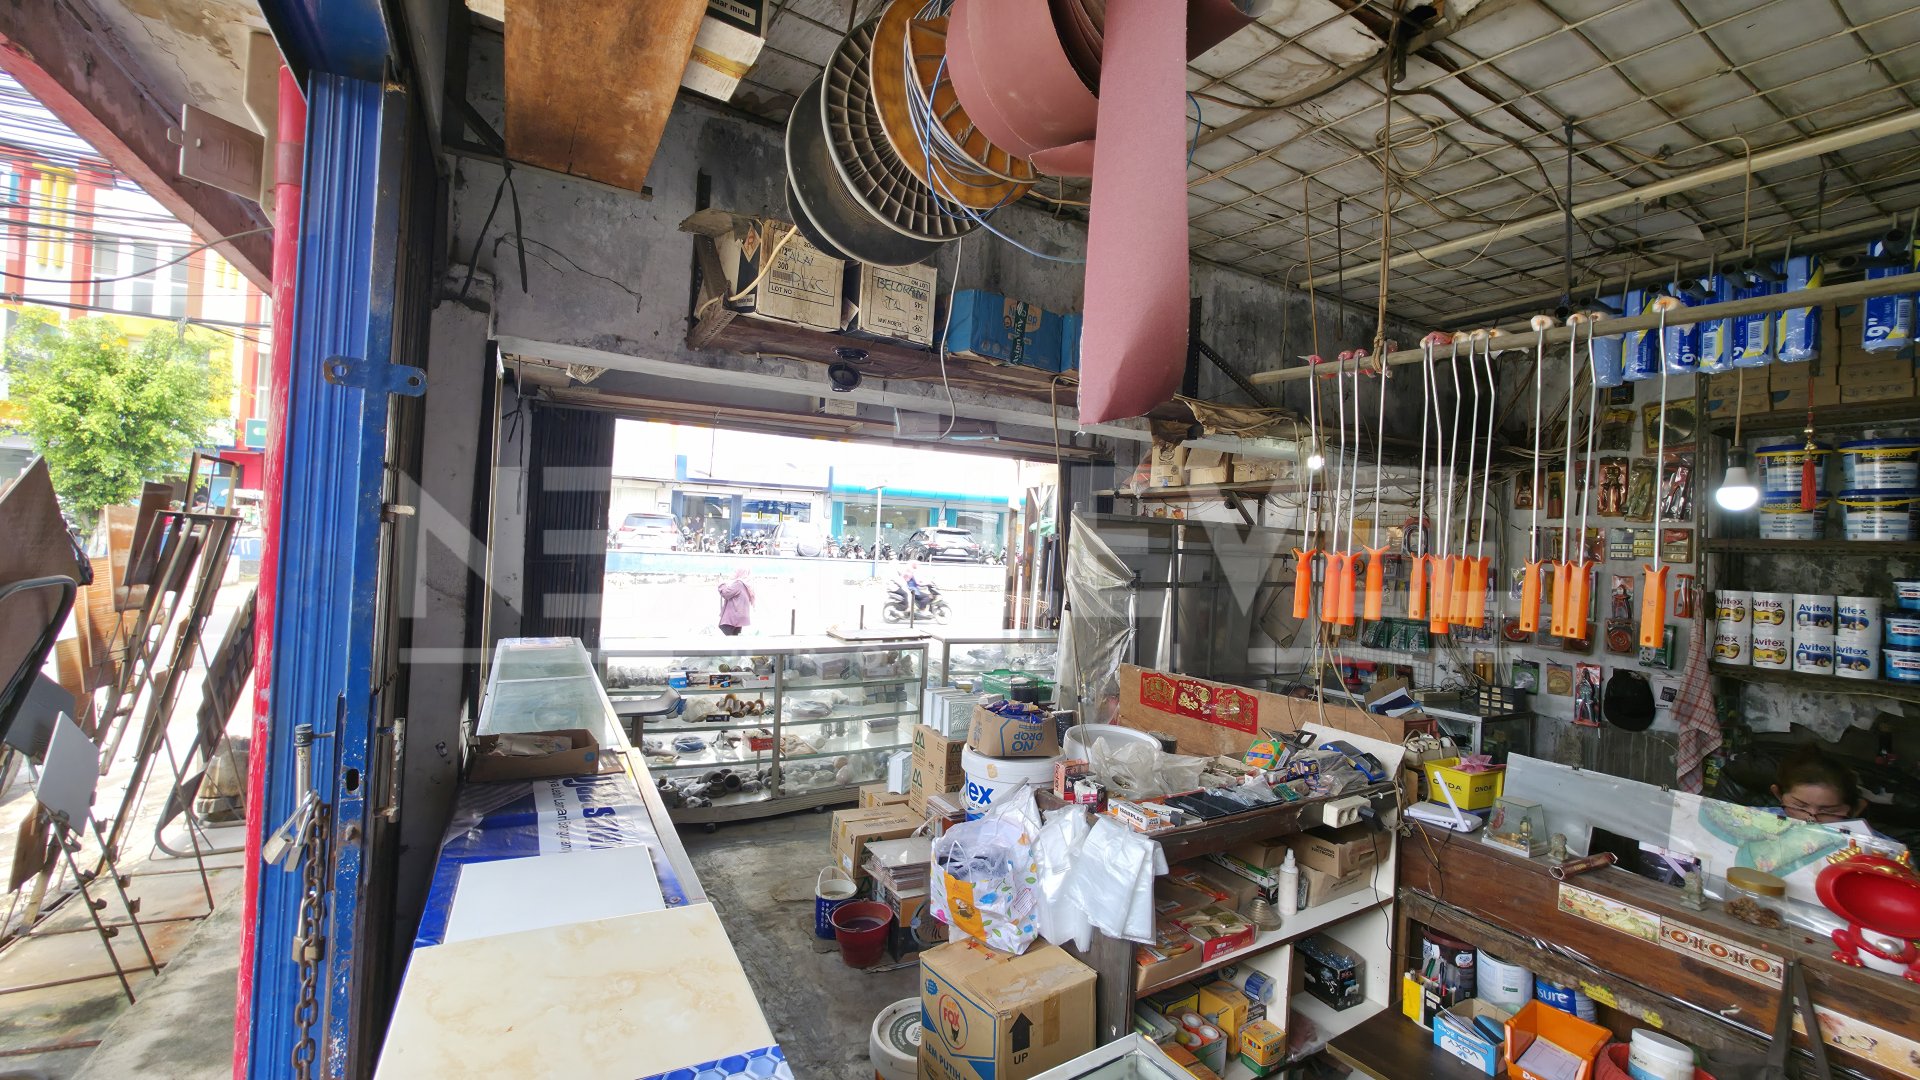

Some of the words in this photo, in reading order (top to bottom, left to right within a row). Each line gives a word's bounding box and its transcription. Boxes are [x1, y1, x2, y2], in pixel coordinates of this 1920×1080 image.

[730, 4, 750, 18] mutu
[777, 261, 789, 271] 300
[771, 285, 782, 293] LOT
[1773, 455, 1818, 463] Aquapf
[1799, 603, 1832, 613] Avitex
[1754, 637, 1785, 647] Avitex
[1798, 642, 1831, 652] Avitex
[1014, 731, 1043, 741] DROP
[1011, 740, 1035, 752] NO
[1433, 778, 1463, 791] ODA
[1474, 785, 1492, 793] ONDA
[943, 1008, 960, 1028] FOX
[925, 1040, 938, 1061] LEM
[939, 1055, 961, 1080] PUTIH
[1013, 1052, 1029, 1065] UP
